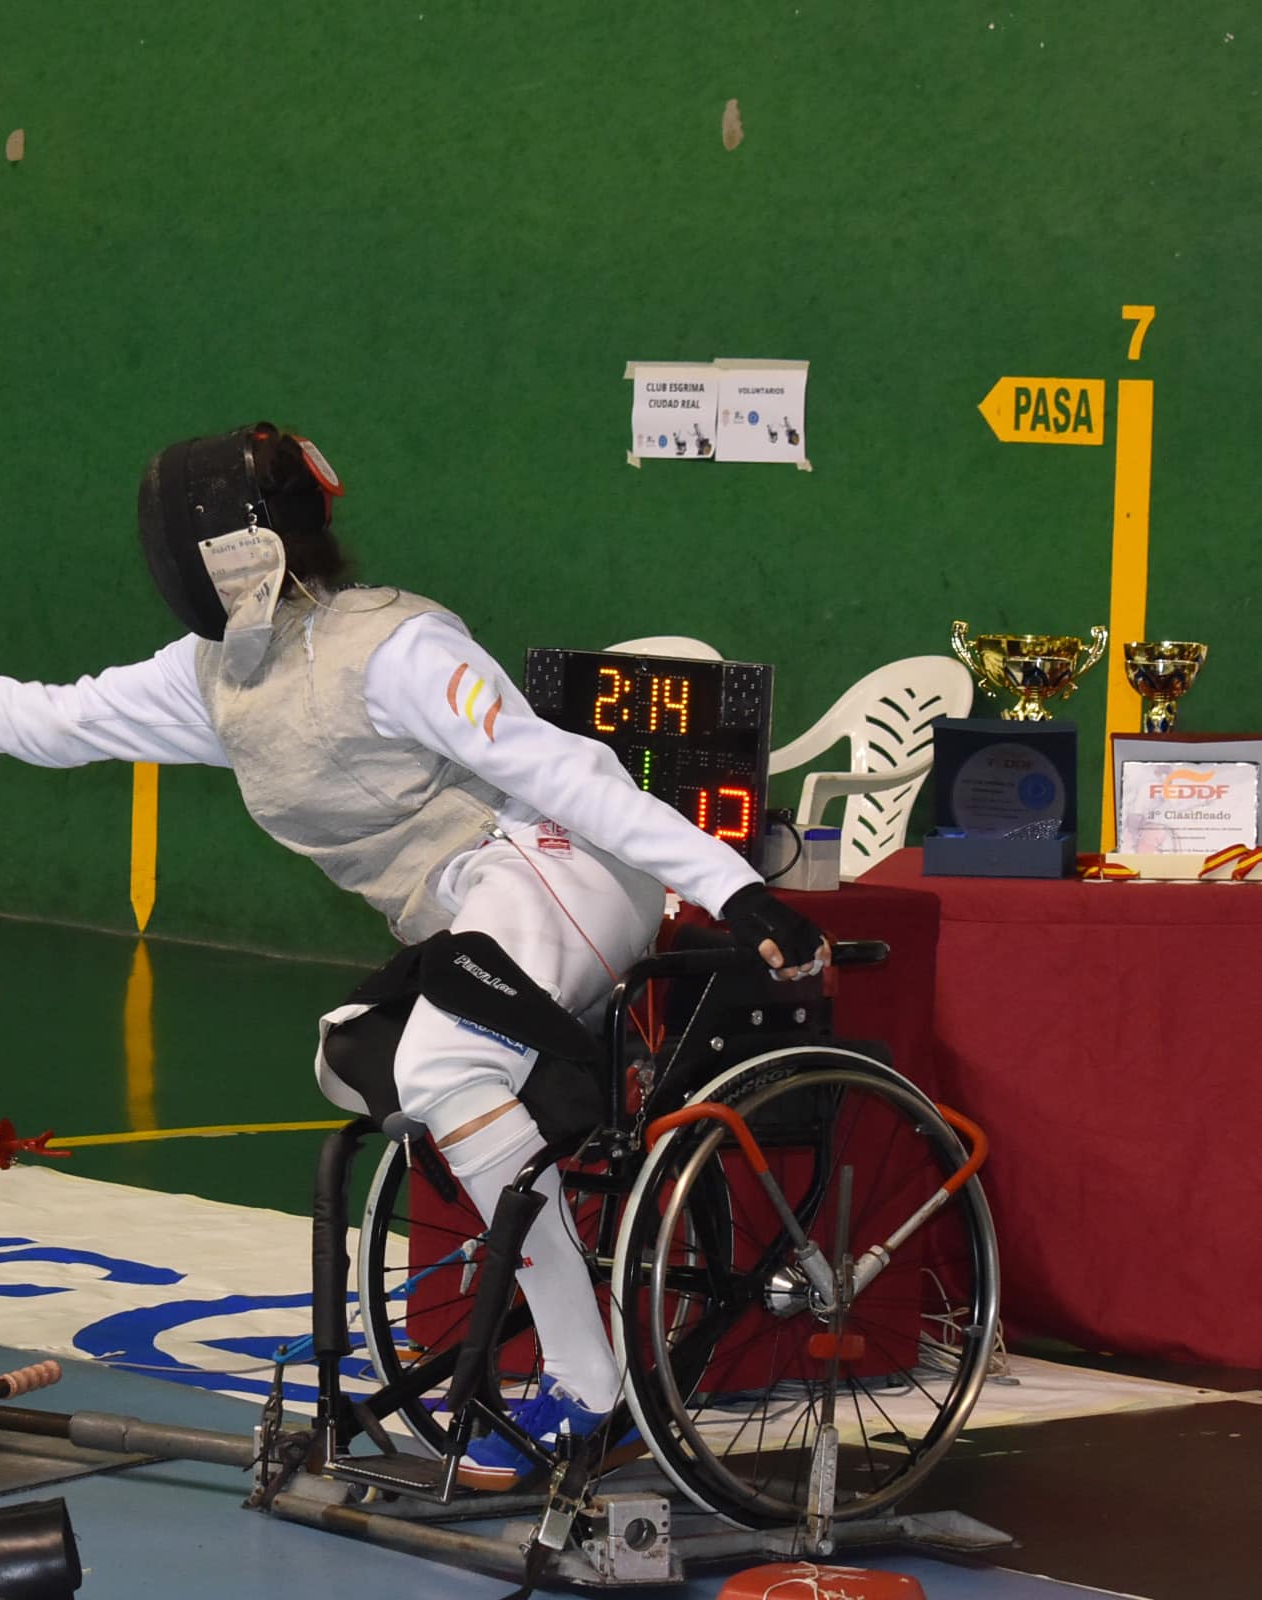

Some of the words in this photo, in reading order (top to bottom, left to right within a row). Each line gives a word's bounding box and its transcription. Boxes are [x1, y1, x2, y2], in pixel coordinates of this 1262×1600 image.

[1121, 305, 1156, 360] 7
[645, 382, 668, 392] CLUB
[668, 383, 705, 393] ESGRIMA
[738, 387, 785, 395] VOLUNTARIOS
[648, 399, 680, 409] CIUDAD
[680, 400, 700, 409] REAL
[1014, 386, 1094, 434] PASA
[594, 668, 689, 734] 2:14
[1149, 779, 1230, 800] FEDDF
[1164, 810, 1231, 821] Clasificado
